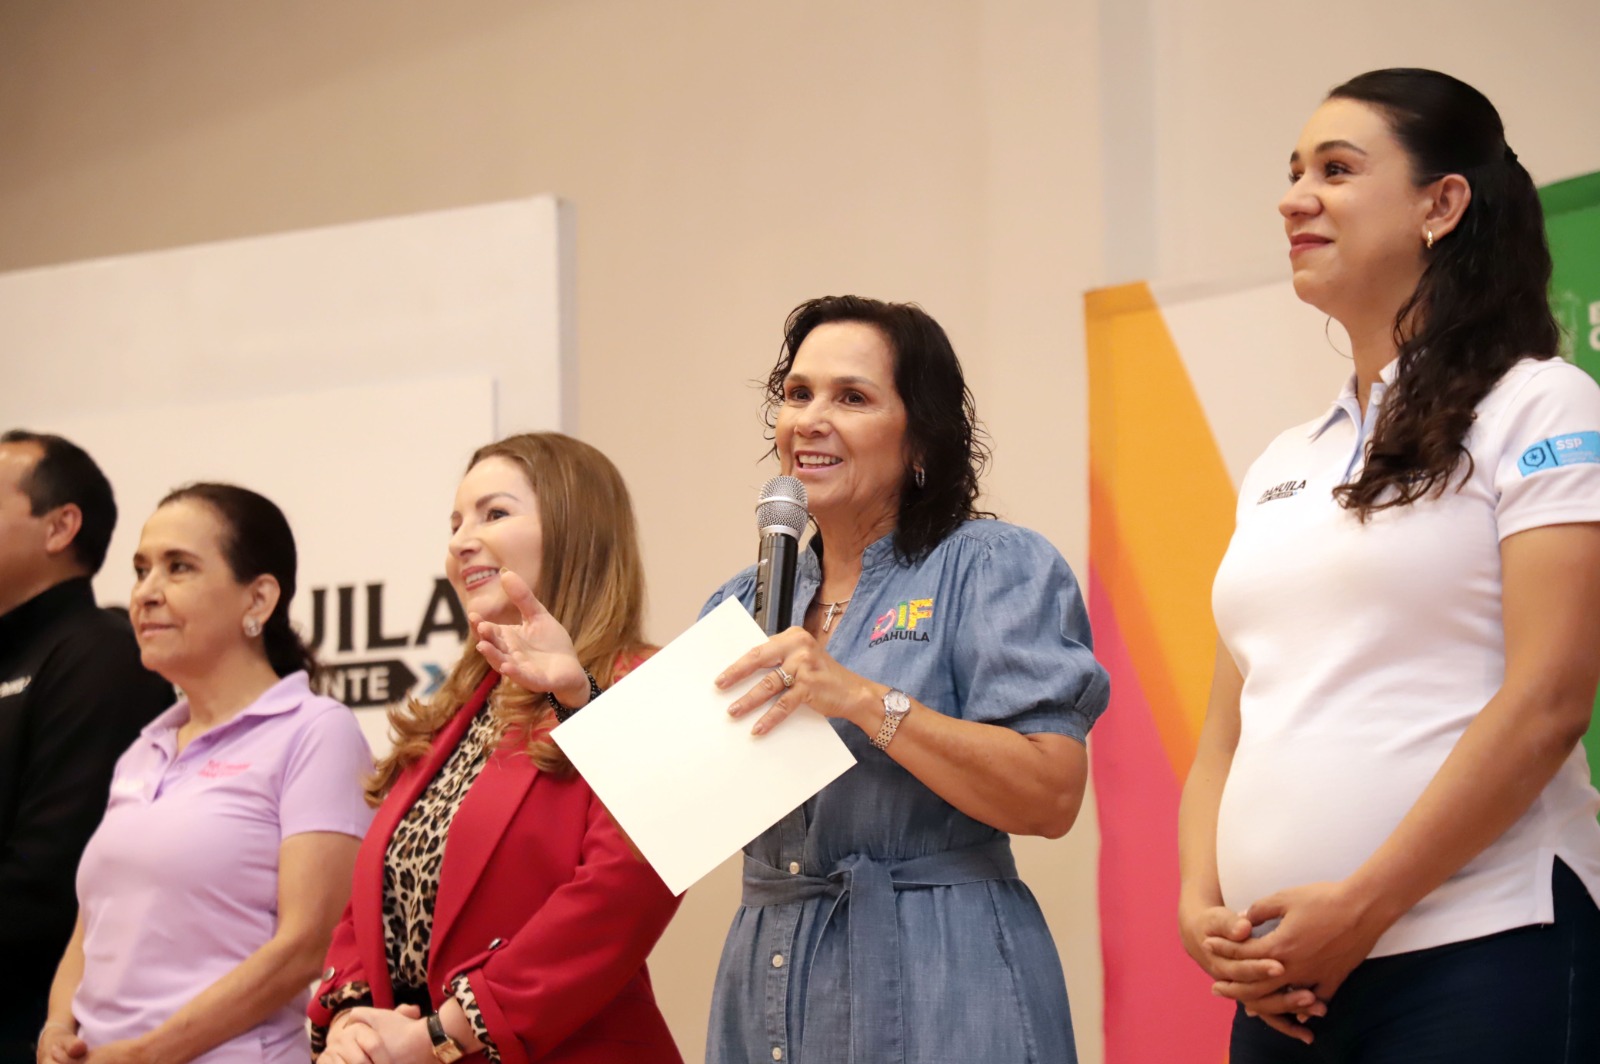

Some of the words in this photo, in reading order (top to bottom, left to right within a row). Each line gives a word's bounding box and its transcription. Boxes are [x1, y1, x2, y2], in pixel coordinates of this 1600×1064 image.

[1555, 438, 1583, 451] SSP
[871, 598, 934, 640] DIF
[868, 630, 930, 648] COAHUILA
